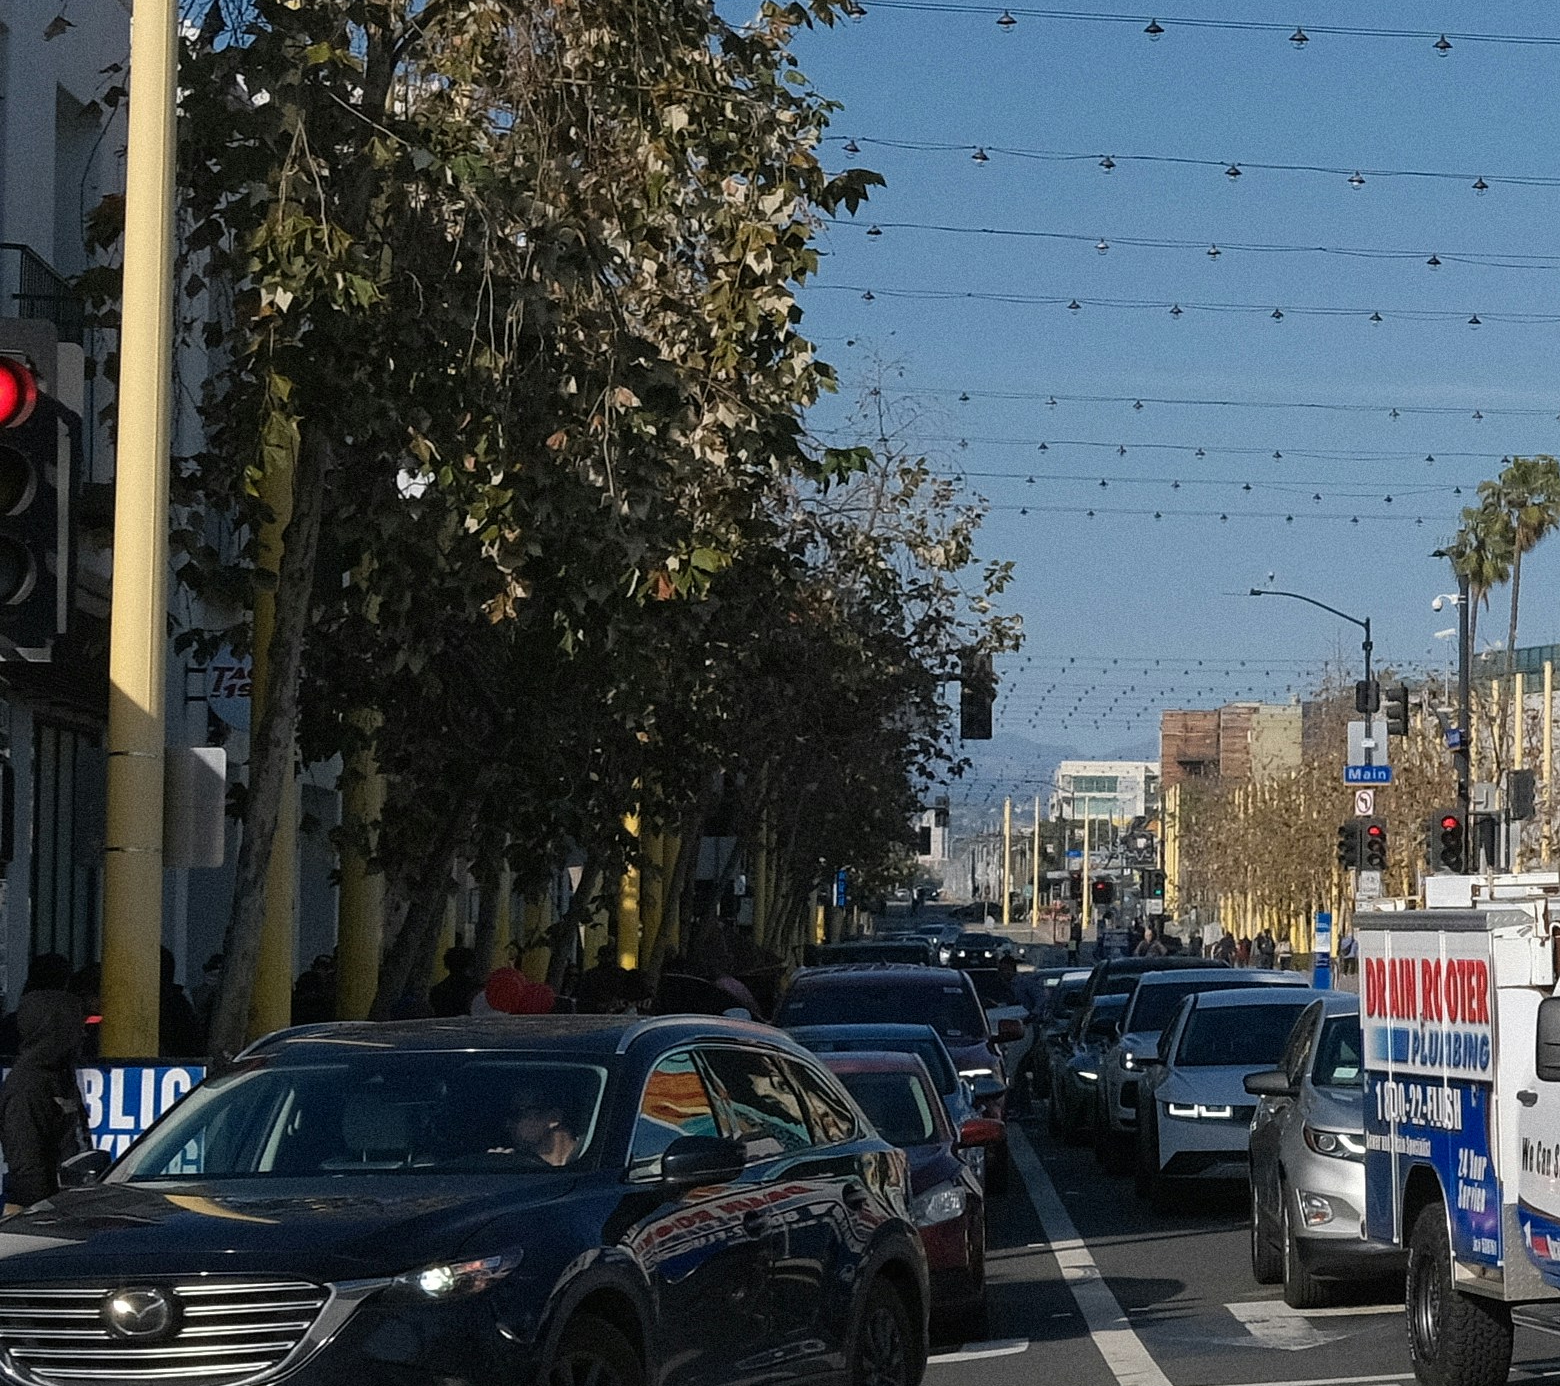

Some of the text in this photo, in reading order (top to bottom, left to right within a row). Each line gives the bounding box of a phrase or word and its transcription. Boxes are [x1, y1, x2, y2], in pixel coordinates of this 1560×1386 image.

[1348, 768, 1387, 781] Main
[1365, 957, 1489, 1024] DRAIN ROOTER
[1411, 1028, 1490, 1072] PLUMBING
[76, 1067, 192, 1130] BLIC
[1457, 1147, 1488, 1182] 24 Hour
[1522, 1136, 1534, 1172] We
[1536, 1140, 1551, 1176] Can
[1457, 1179, 1486, 1213] Service
